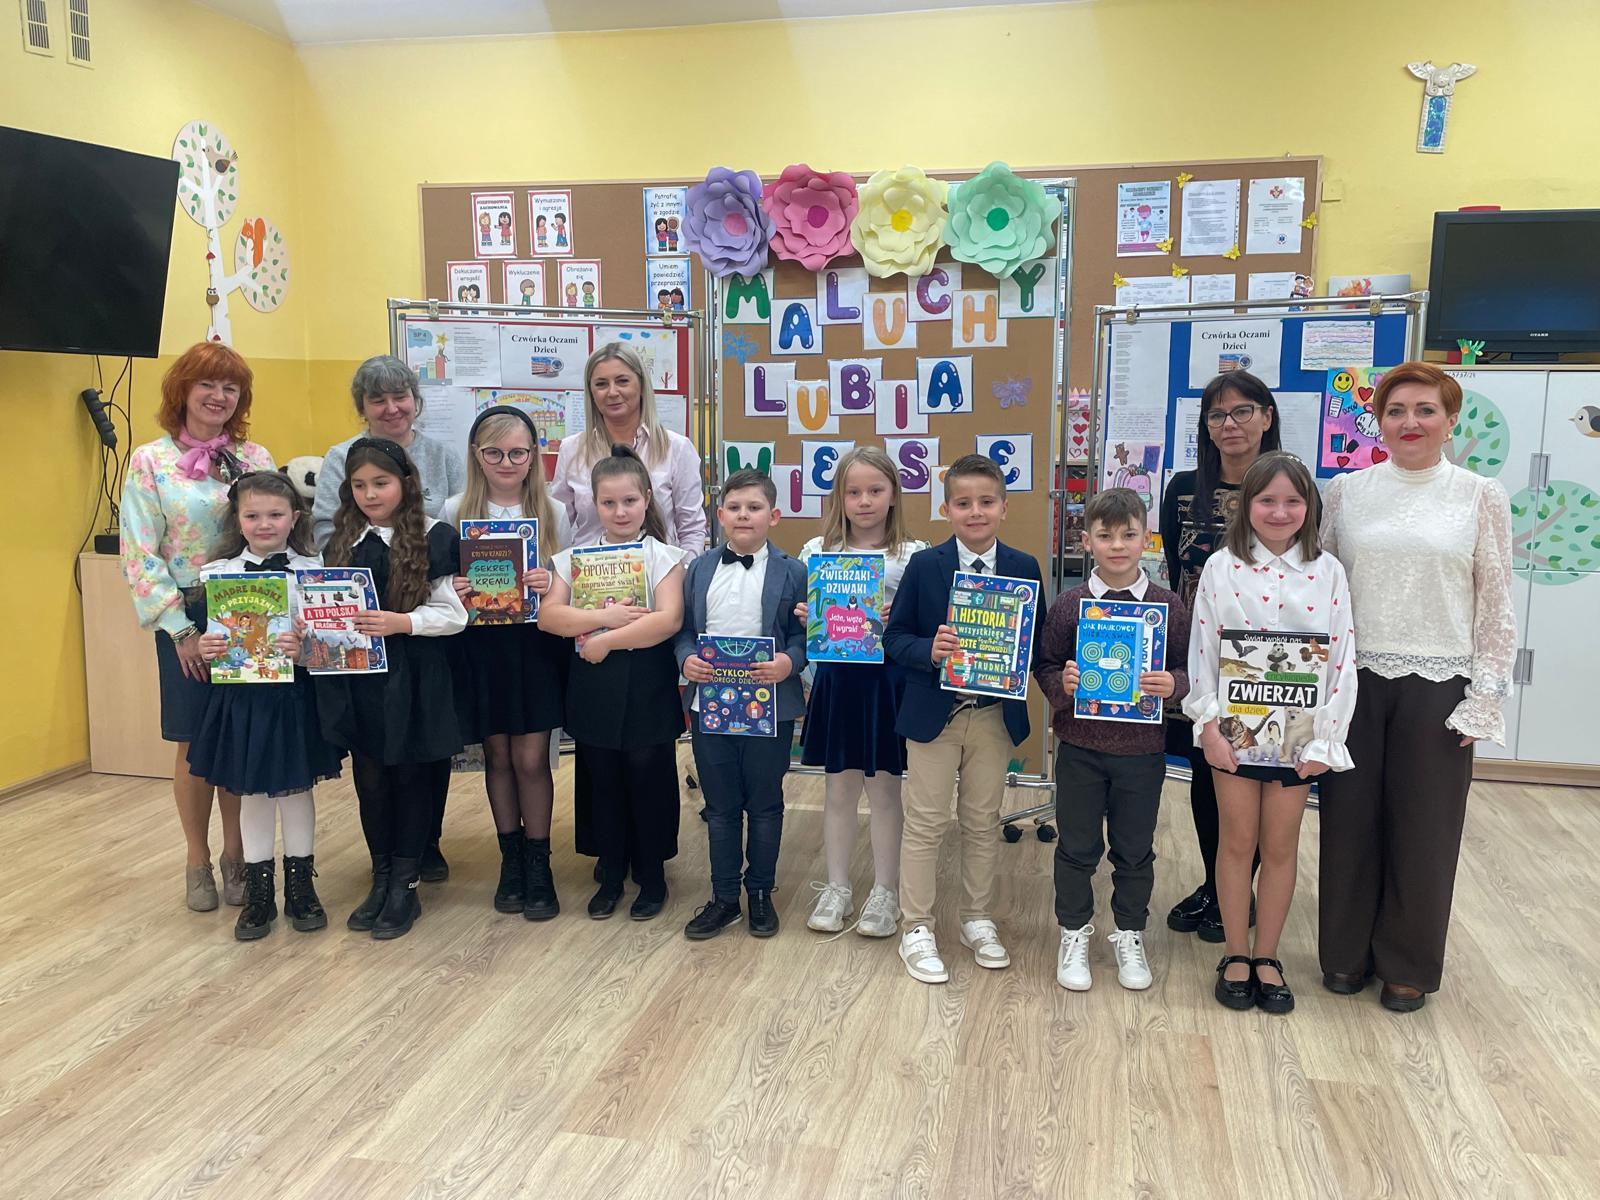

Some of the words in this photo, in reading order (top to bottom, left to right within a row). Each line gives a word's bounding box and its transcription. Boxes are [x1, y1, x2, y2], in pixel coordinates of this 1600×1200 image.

[726, 262, 1046, 350] MALUCHY
[511, 333, 547, 343] Czwórka
[549, 335, 579, 344] Oczami
[1201, 331, 1237, 340] Czwórka
[1239, 329, 1271, 339] Oczami
[533, 345, 558, 354] Dzieci
[1222, 341, 1247, 350] Dzieci
[754, 360, 964, 432] LUBIĄ
[474, 564, 509, 572] SEKRET
[583, 559, 632, 577] OPOWIEŚCI
[475, 578, 510, 588] KREMU
[213, 584, 249, 602] MĄDRE
[250, 584, 282, 602] BAJKI
[306, 610, 313, 618] A
[313, 608, 324, 618] TO
[326, 606, 356, 617] POLSKA
[959, 607, 1006, 629] HISTORIA
[958, 625, 1005, 641] wszystkiego
[1083, 622, 1096, 631] JAK
[1097, 623, 1136, 632] NAUKOWCY
[959, 637, 977, 649] OSTE
[1229, 682, 1316, 708] ZWIERZĄT
[1230, 705, 1242, 713] dla
[1244, 706, 1267, 715] dzieci
